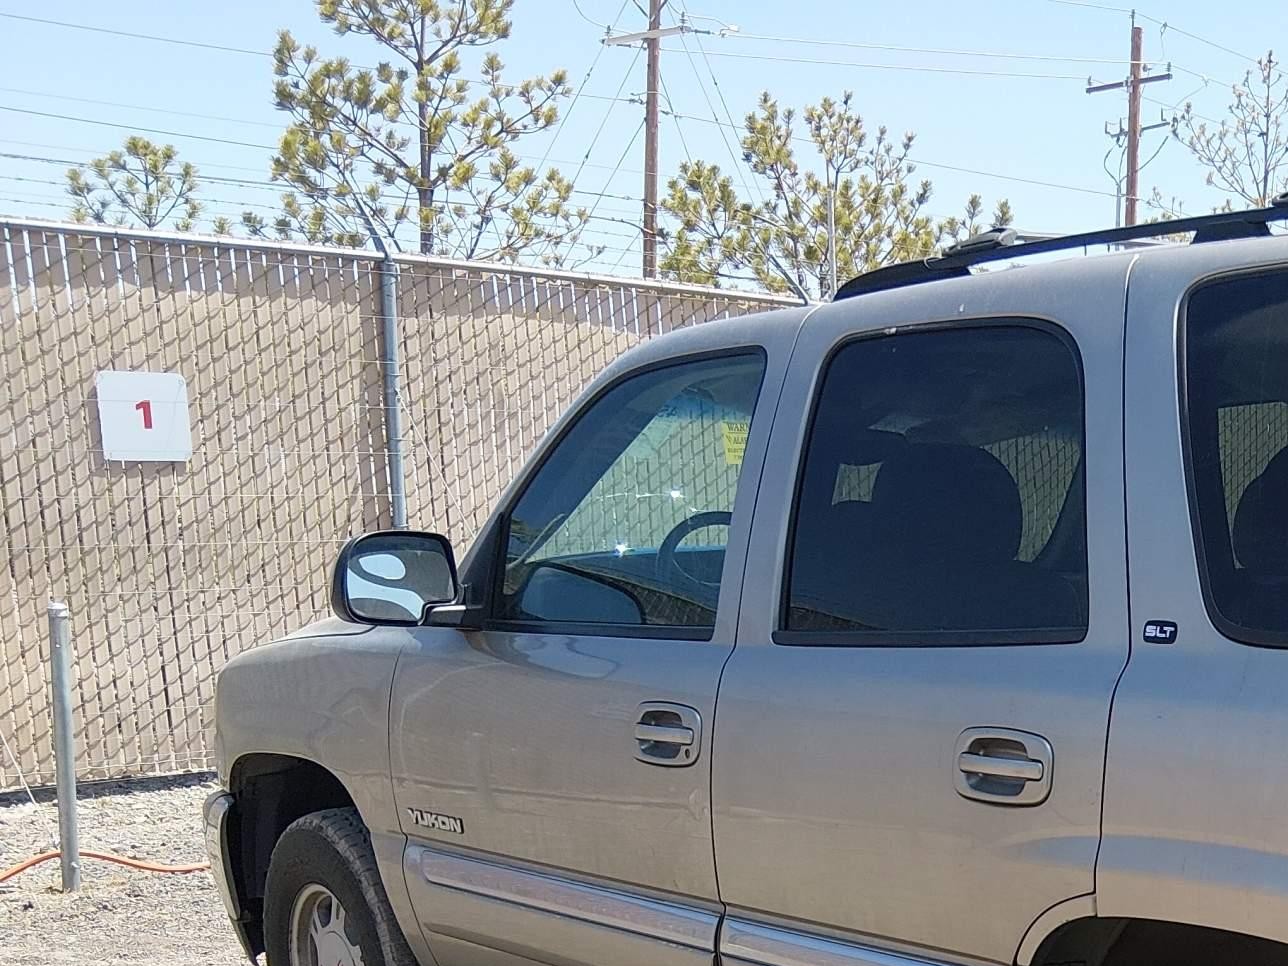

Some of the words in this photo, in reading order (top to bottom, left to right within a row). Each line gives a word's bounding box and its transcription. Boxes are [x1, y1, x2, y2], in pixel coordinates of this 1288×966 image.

[135, 399, 153, 429] 1
[1144, 625, 1175, 638] SLT
[407, 807, 464, 834] YUKON
